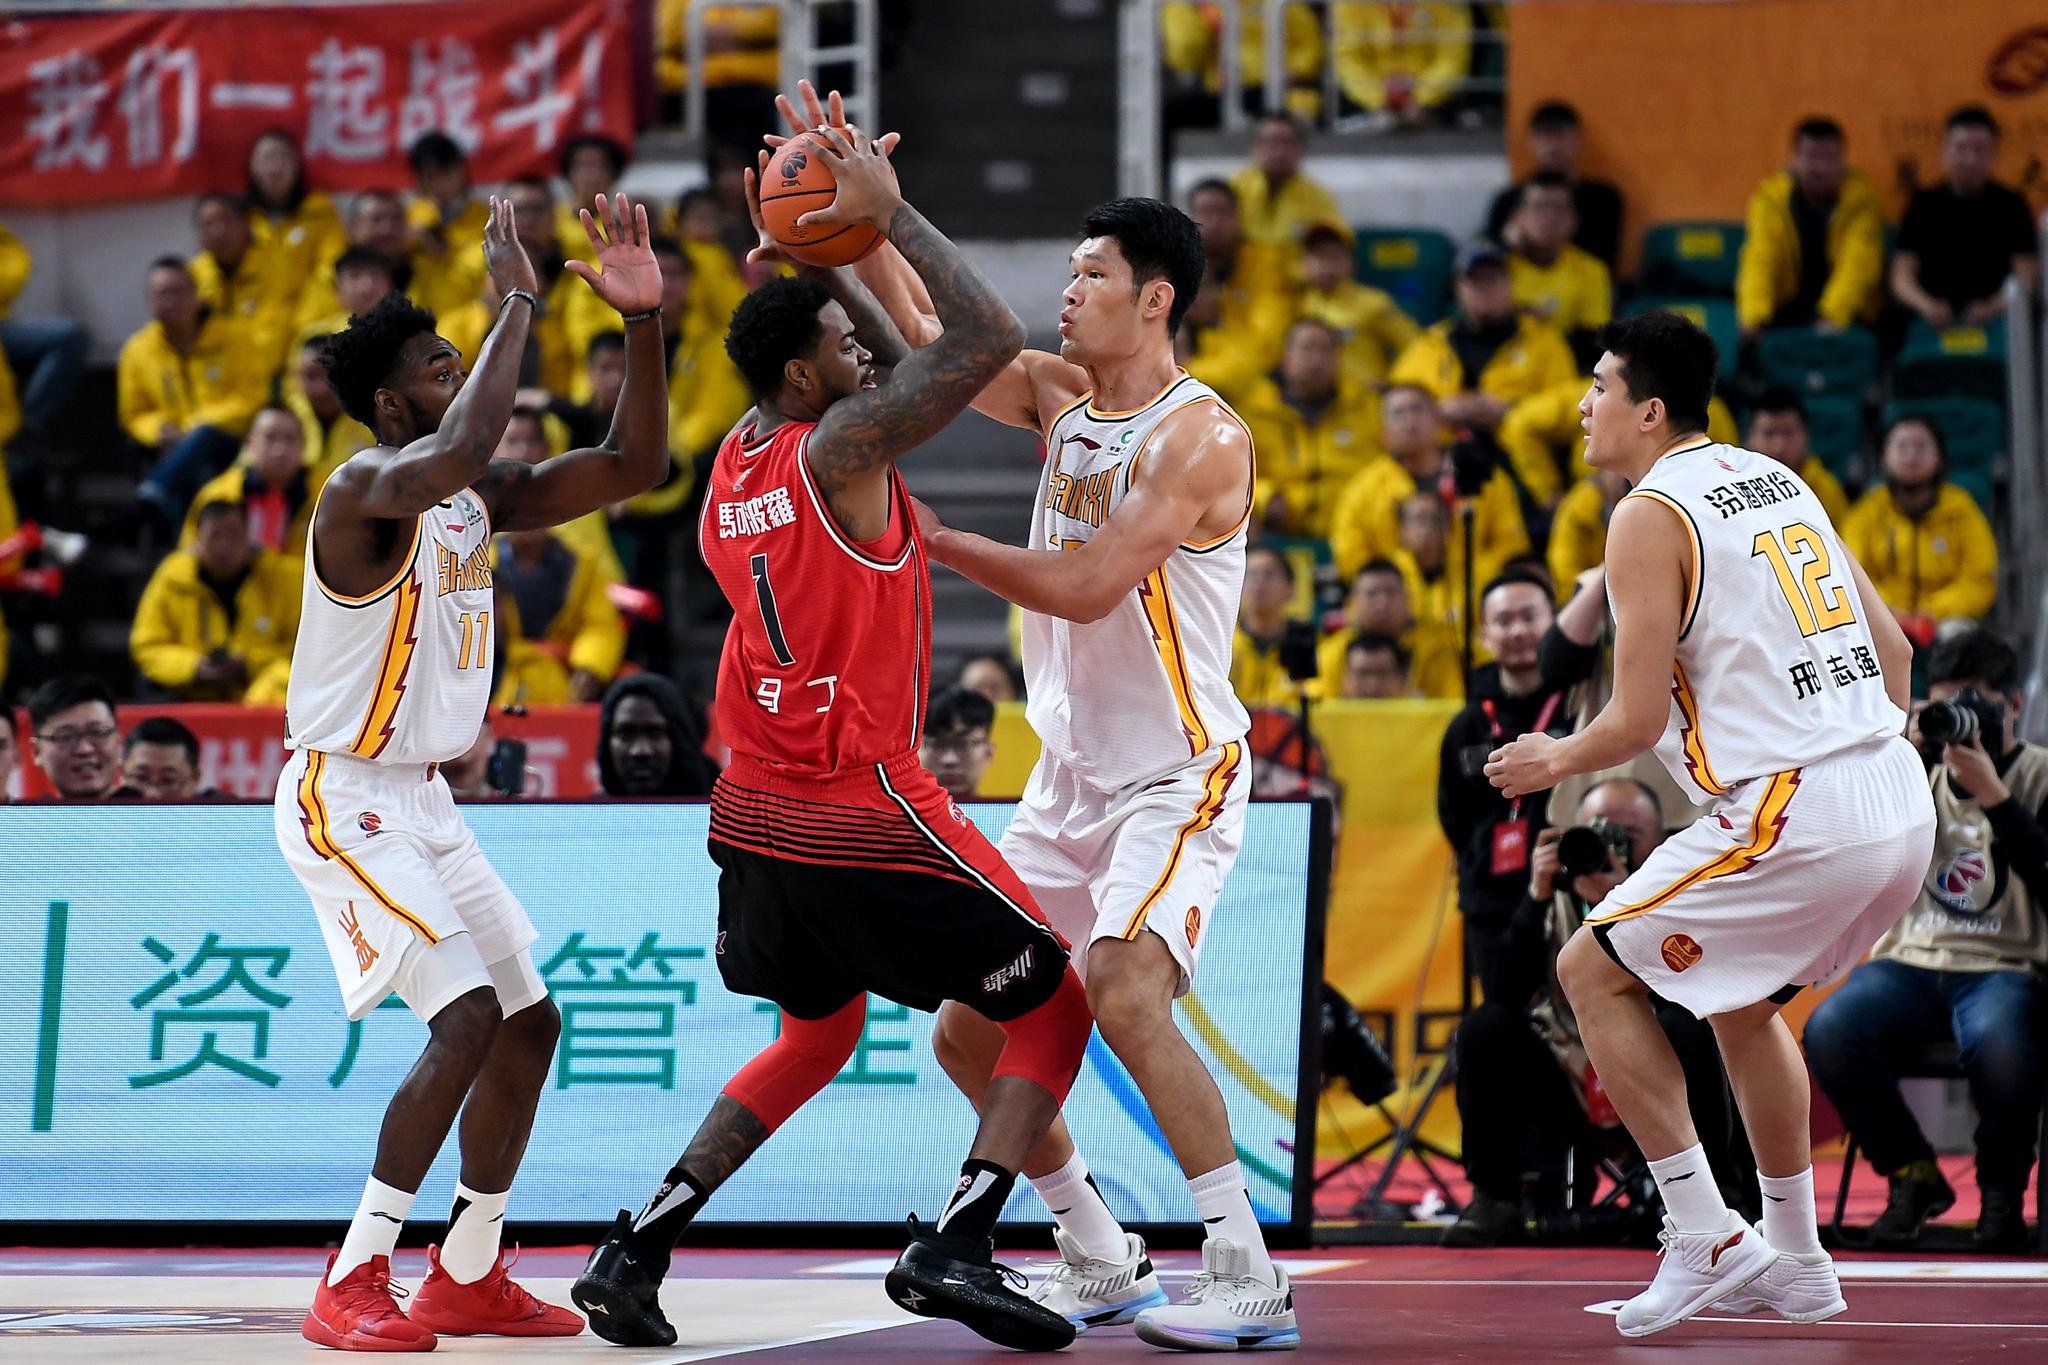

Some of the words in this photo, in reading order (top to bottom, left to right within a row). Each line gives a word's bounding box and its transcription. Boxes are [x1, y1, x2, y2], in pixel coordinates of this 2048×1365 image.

[718, 485, 797, 539] 馬可波羅
[1703, 471, 1801, 520] 汾酒股份
[1750, 521, 1857, 639] 12
[750, 552, 797, 667] 1
[458, 611, 490, 670] 11
[1788, 645, 1881, 700] 邢志强
